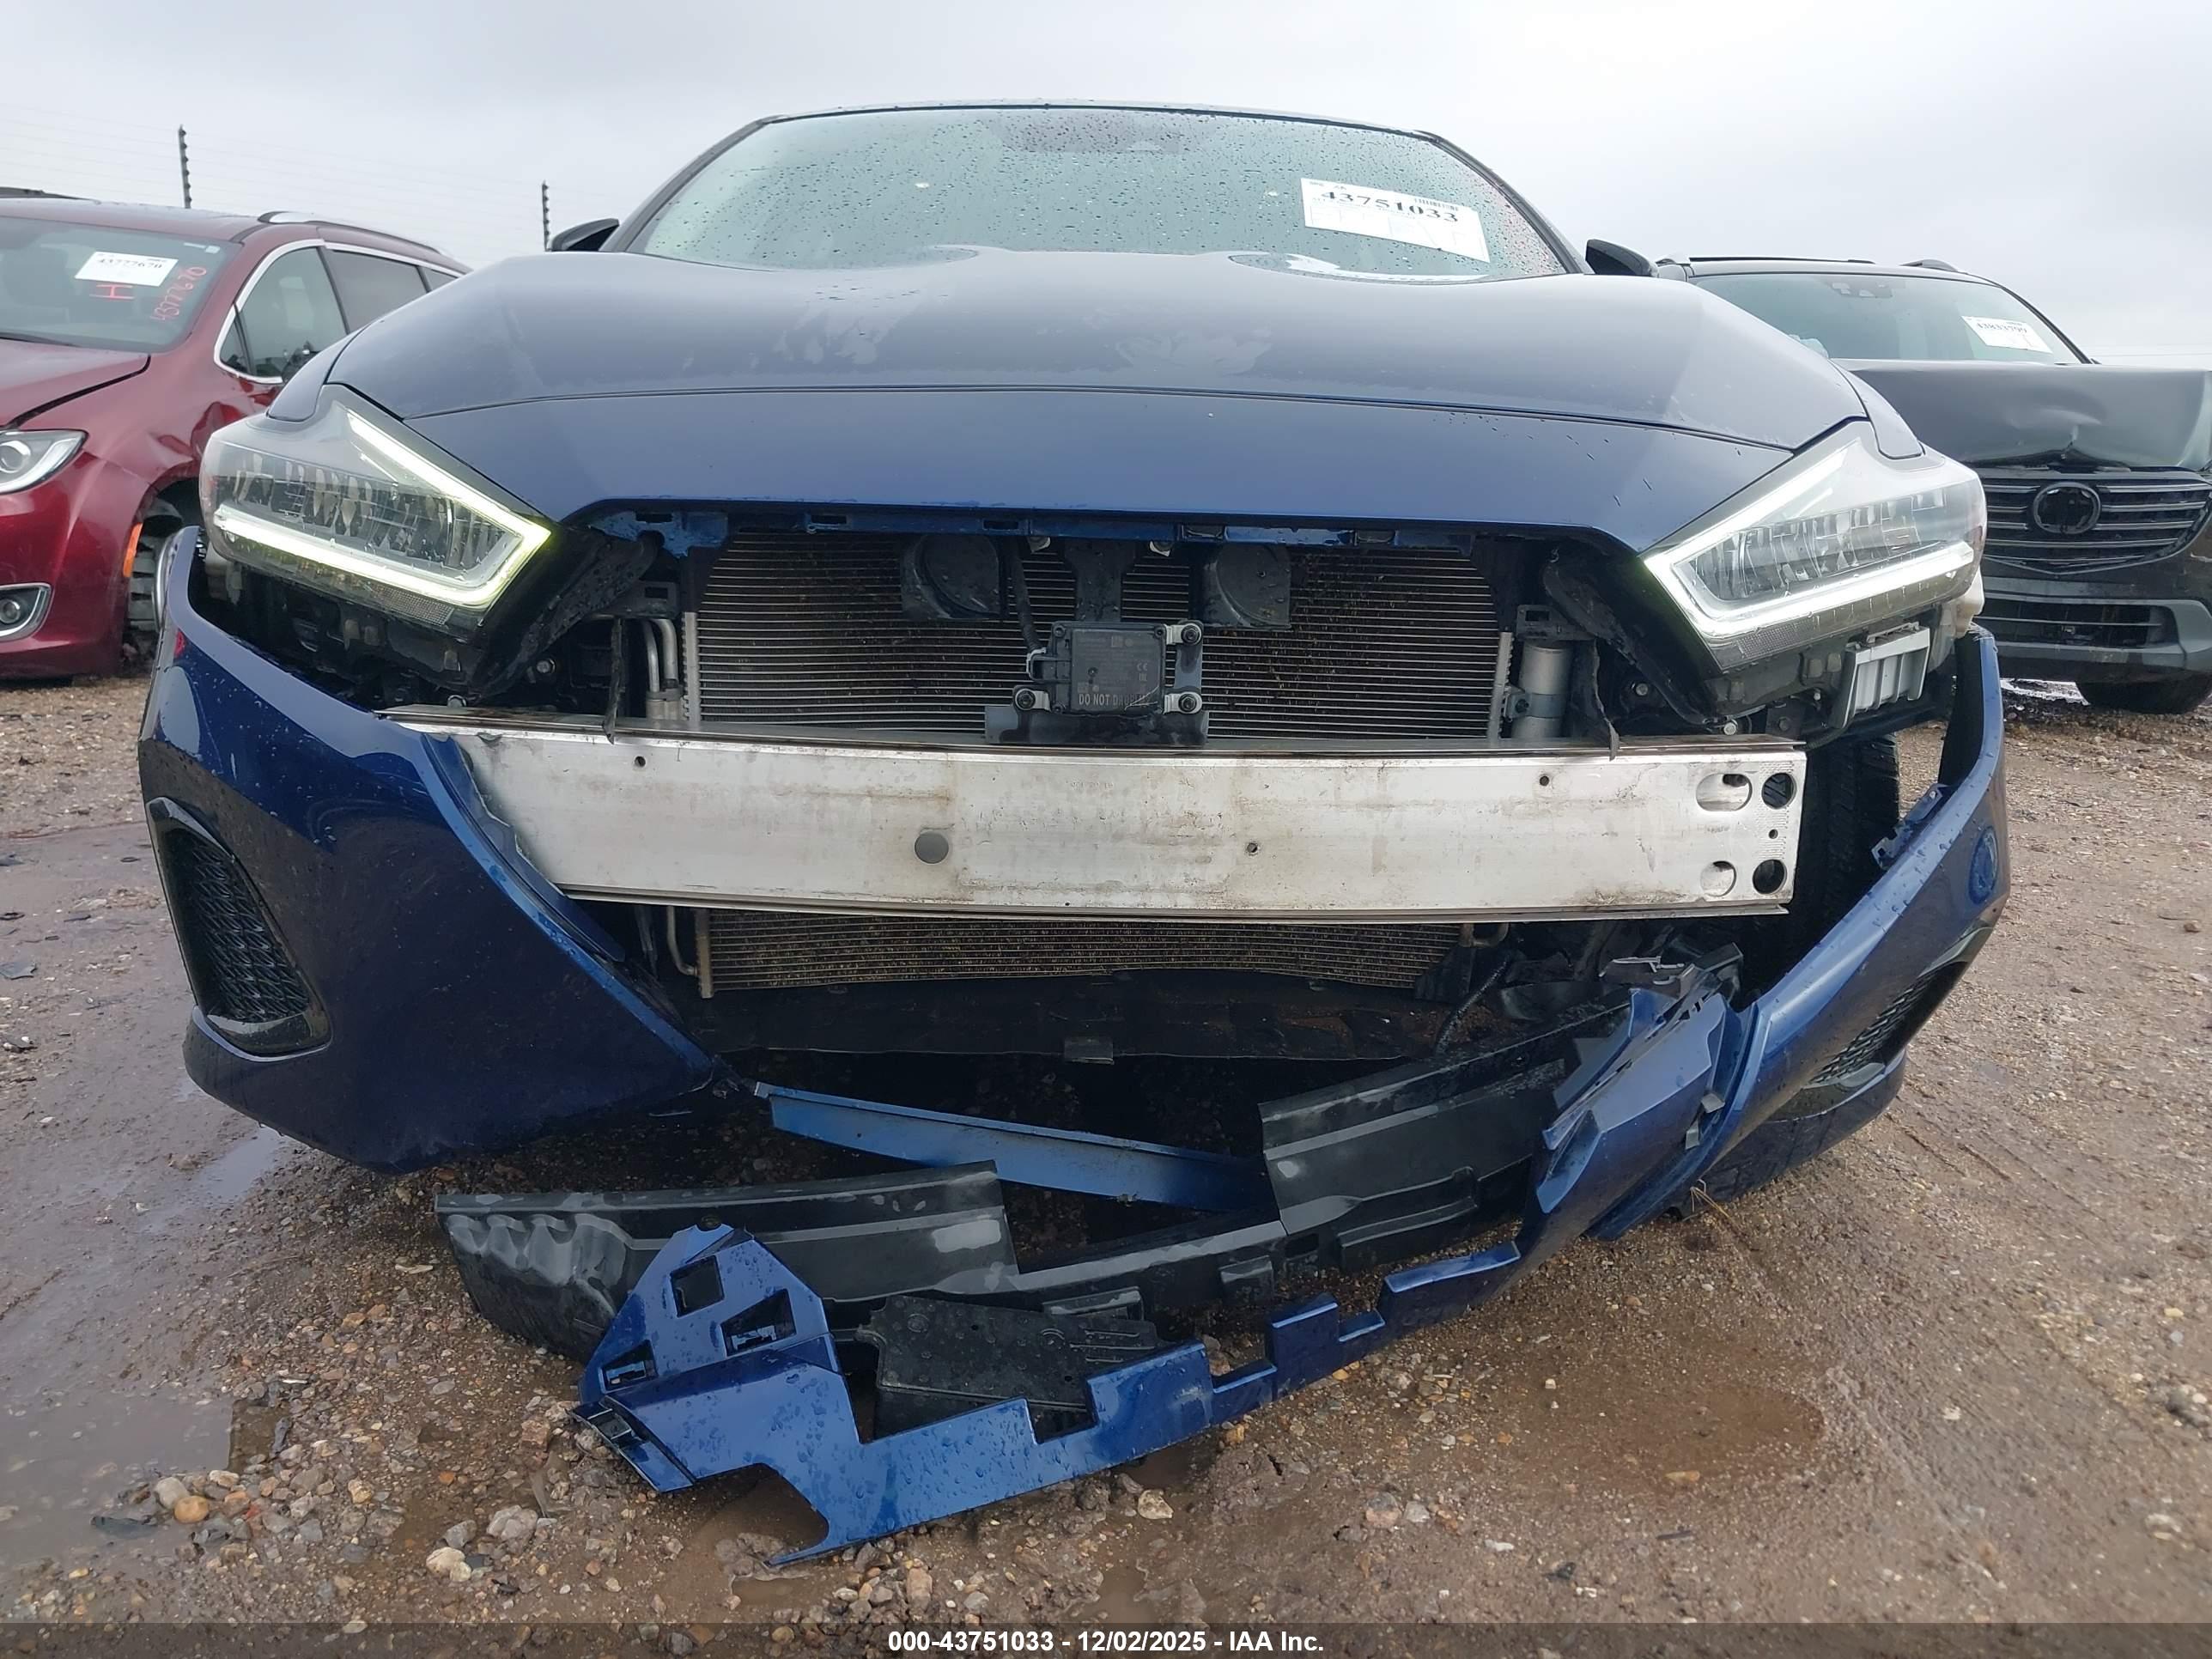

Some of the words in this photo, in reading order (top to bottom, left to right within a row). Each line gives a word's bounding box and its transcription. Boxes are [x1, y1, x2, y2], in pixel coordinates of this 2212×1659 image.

[1320, 191, 1459, 222] 43751033
[1079, 693, 1091, 706] DO
[1093, 693, 1111, 706] NOT
